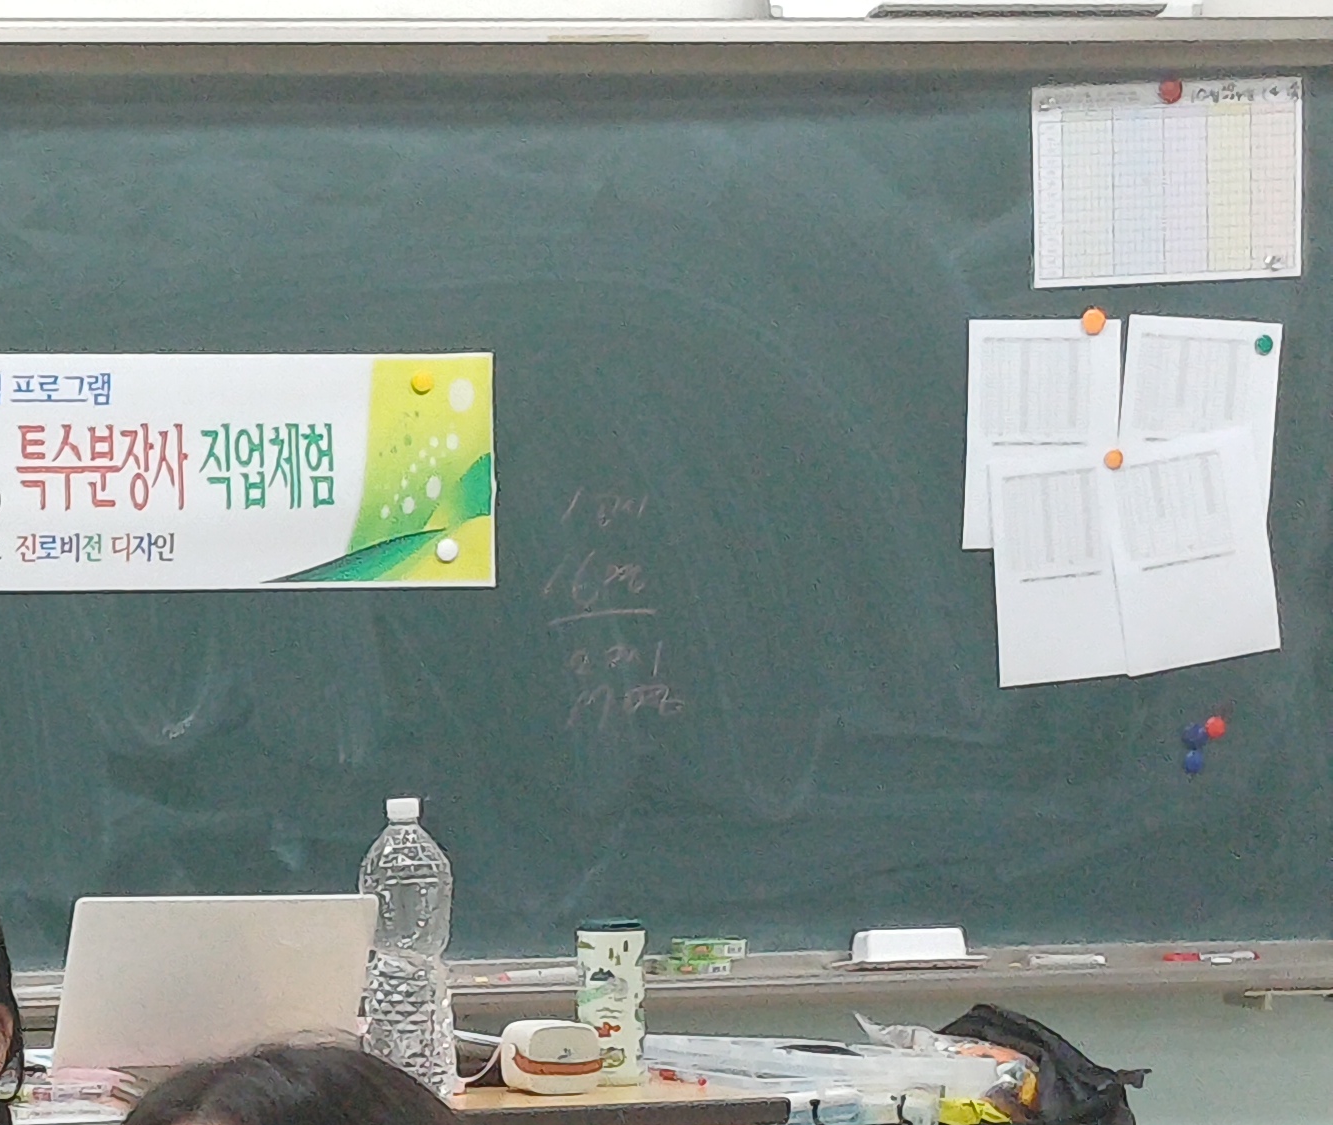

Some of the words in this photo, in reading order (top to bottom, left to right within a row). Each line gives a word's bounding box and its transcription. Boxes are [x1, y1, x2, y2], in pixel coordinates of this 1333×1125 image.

[10, 372, 113, 406] 프로그램
[15, 422, 189, 512] 특수분장사
[199, 422, 336, 510] 직업체험
[15, 532, 103, 564] 진로비전
[111, 532, 176, 563] 디자인
